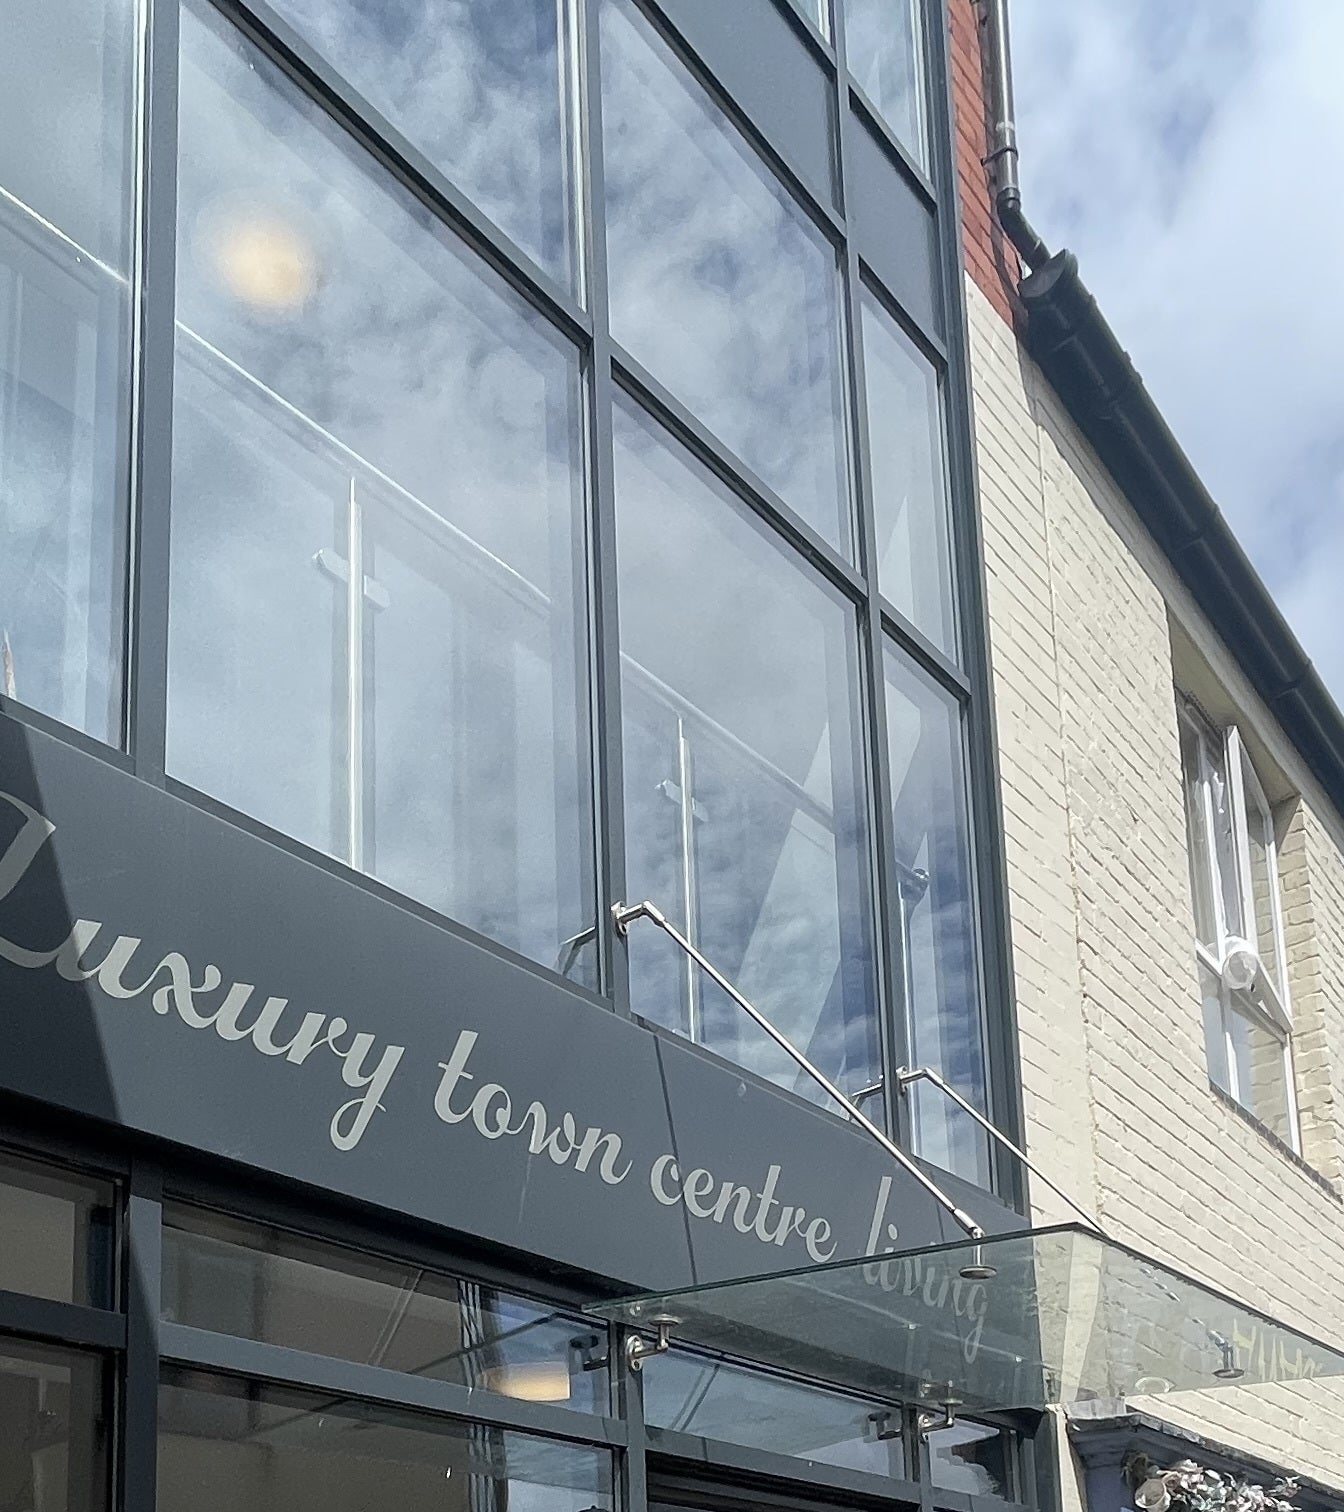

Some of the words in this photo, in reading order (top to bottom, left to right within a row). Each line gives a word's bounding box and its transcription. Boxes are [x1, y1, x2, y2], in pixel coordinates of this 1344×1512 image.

[434, 1029, 633, 1185] town
[650, 1154, 838, 1263] centre
[862, 1175, 987, 1364] living
